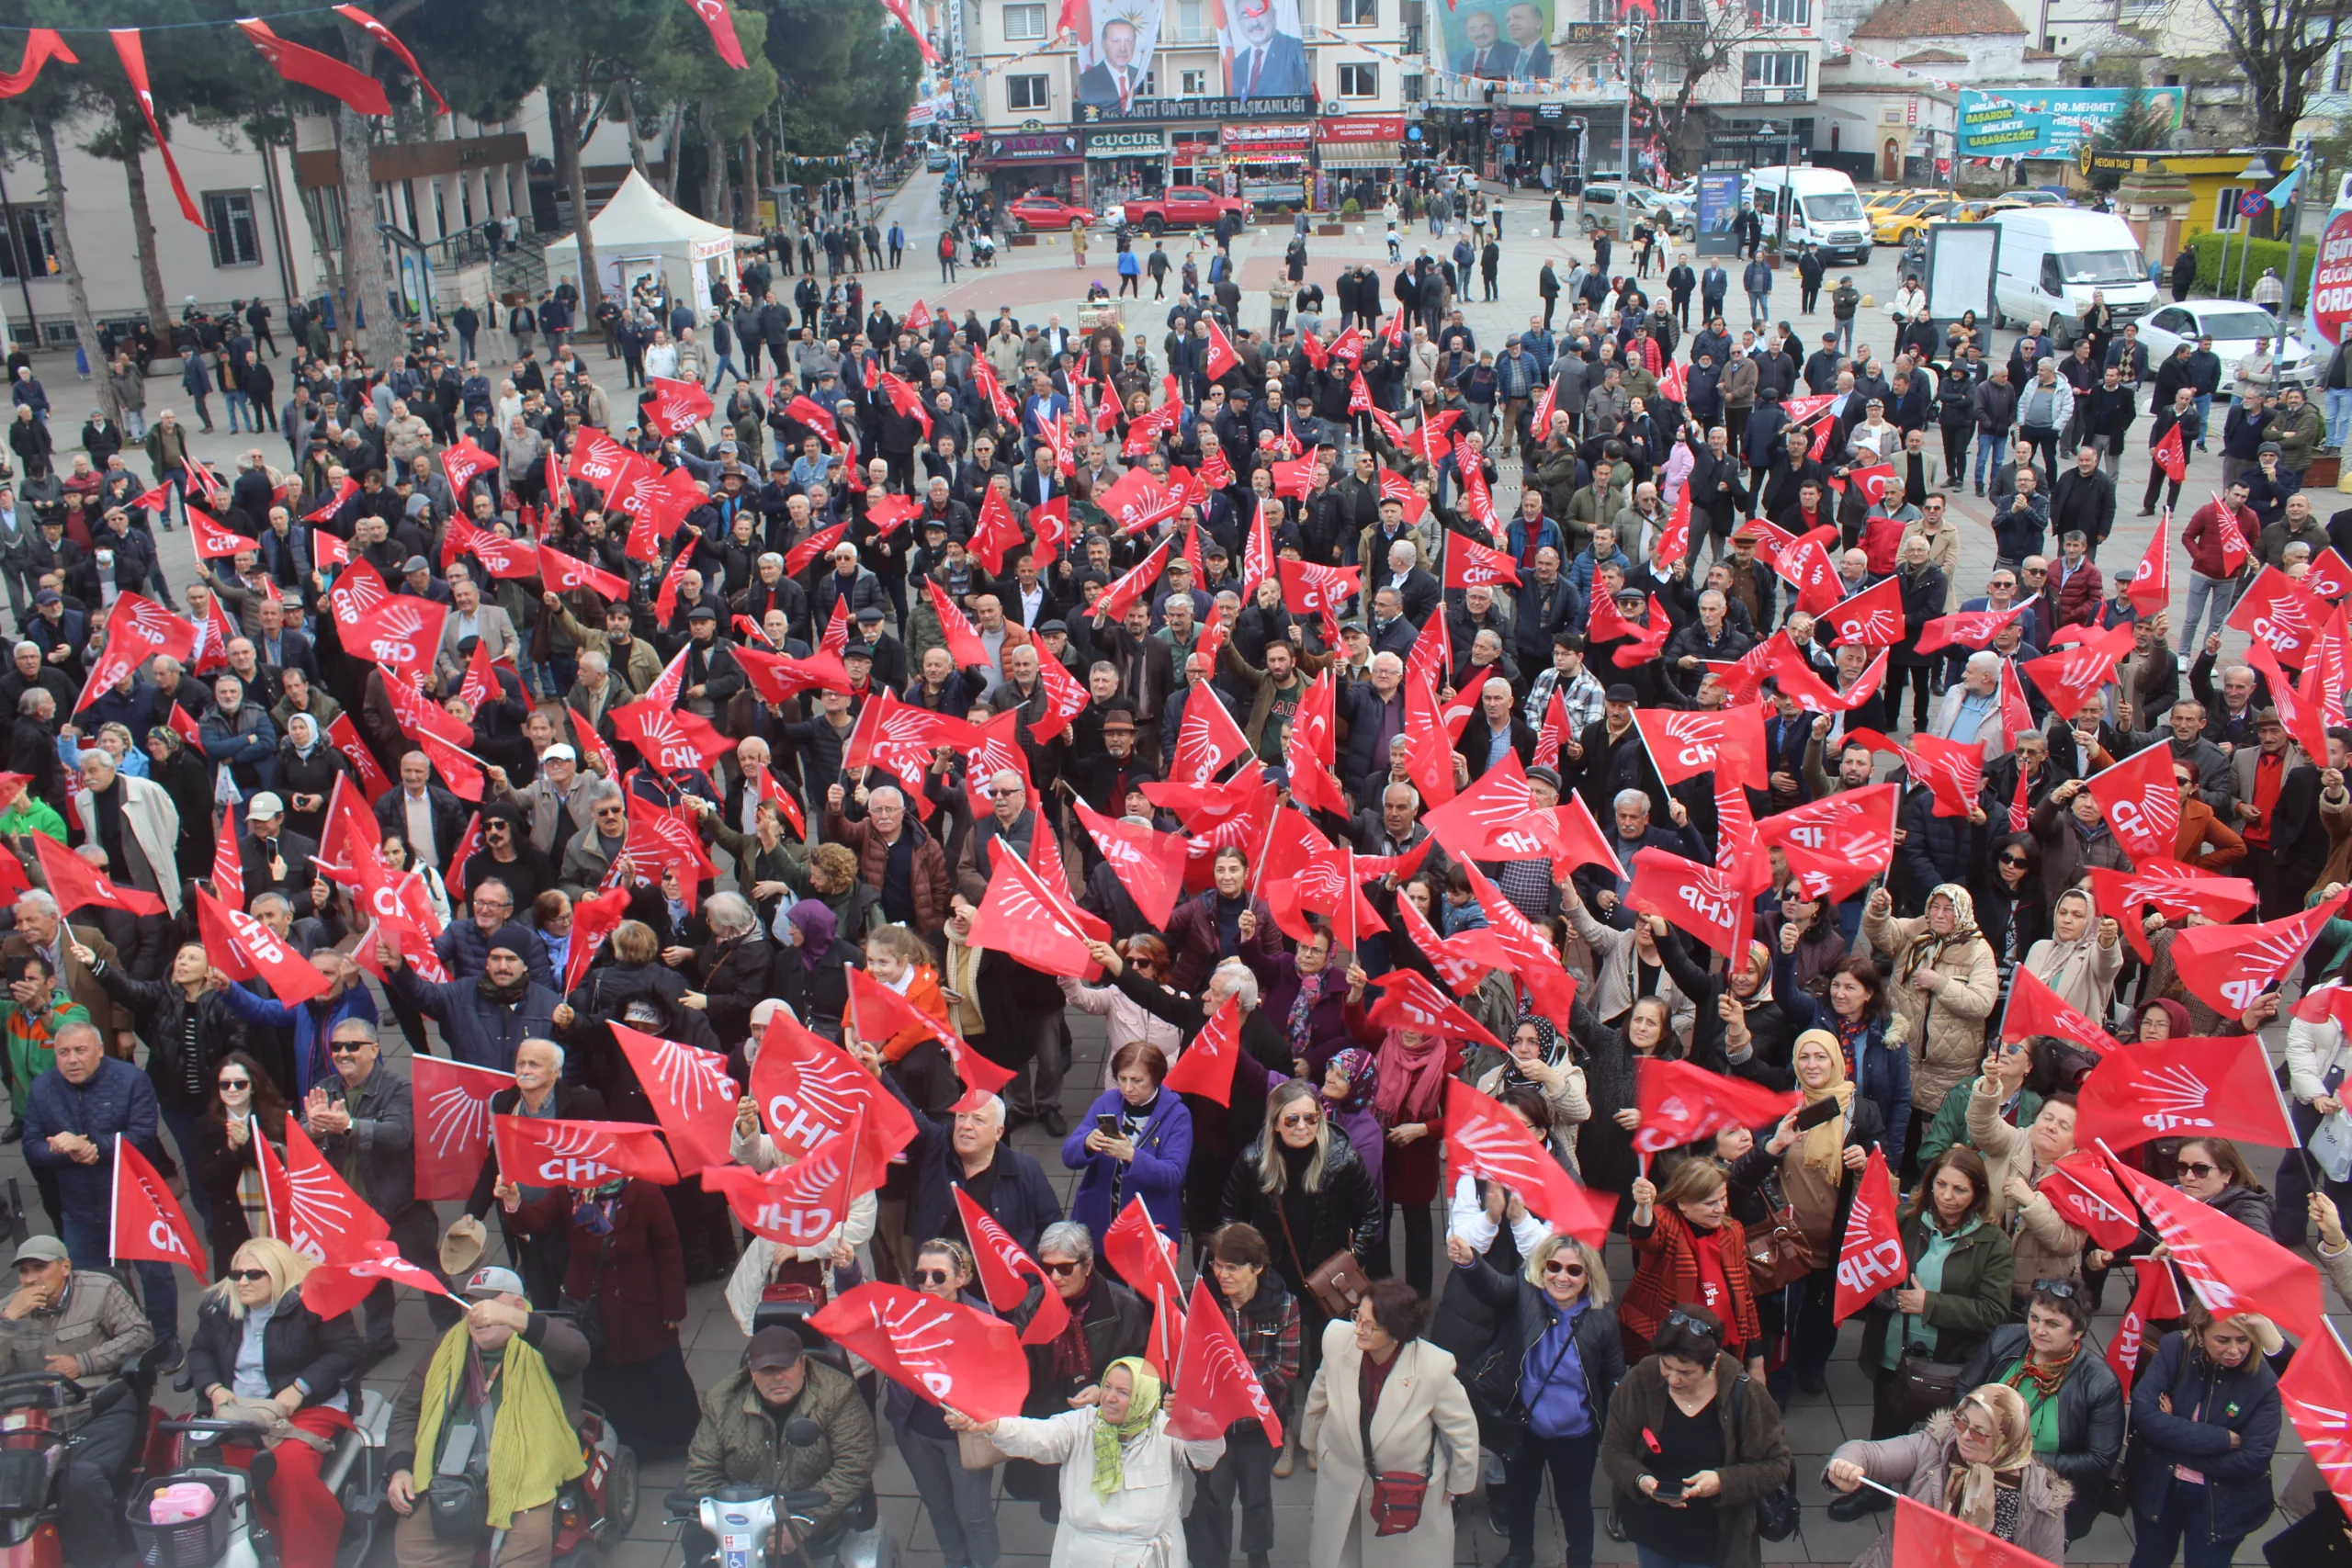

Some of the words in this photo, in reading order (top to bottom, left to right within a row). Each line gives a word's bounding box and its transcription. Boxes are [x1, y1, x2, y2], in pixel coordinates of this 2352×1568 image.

[1160, 100, 1194, 116] ÜNYE
[1199, 98, 1227, 118] İLÇE
[1230, 97, 1306, 118] BAŞKANLIĞI
[1965, 109, 2013, 124] BAŞARDIK
[1981, 119, 2023, 134] BİRLİKTE
[1003, 137, 1059, 149] SARAY
[1969, 129, 2036, 147] BAŞARACAĞIZ
[2095, 157, 2115, 168] MEYDAN
[1337, 347, 1358, 360] CHP
[671, 412, 698, 432] CHP
[455, 462, 477, 486] CHP
[581, 462, 611, 479] CHP
[207, 536, 240, 551] CHP
[1792, 543, 1813, 580] CHP
[333, 588, 359, 625] CHP
[2253, 617, 2299, 653] CHP
[93, 660, 130, 699] CHP
[888, 754, 922, 784] CHP
[2111, 800, 2161, 855] CHP
[229, 908, 284, 964] CHP
[2120, 1312, 2141, 1371] CHP
